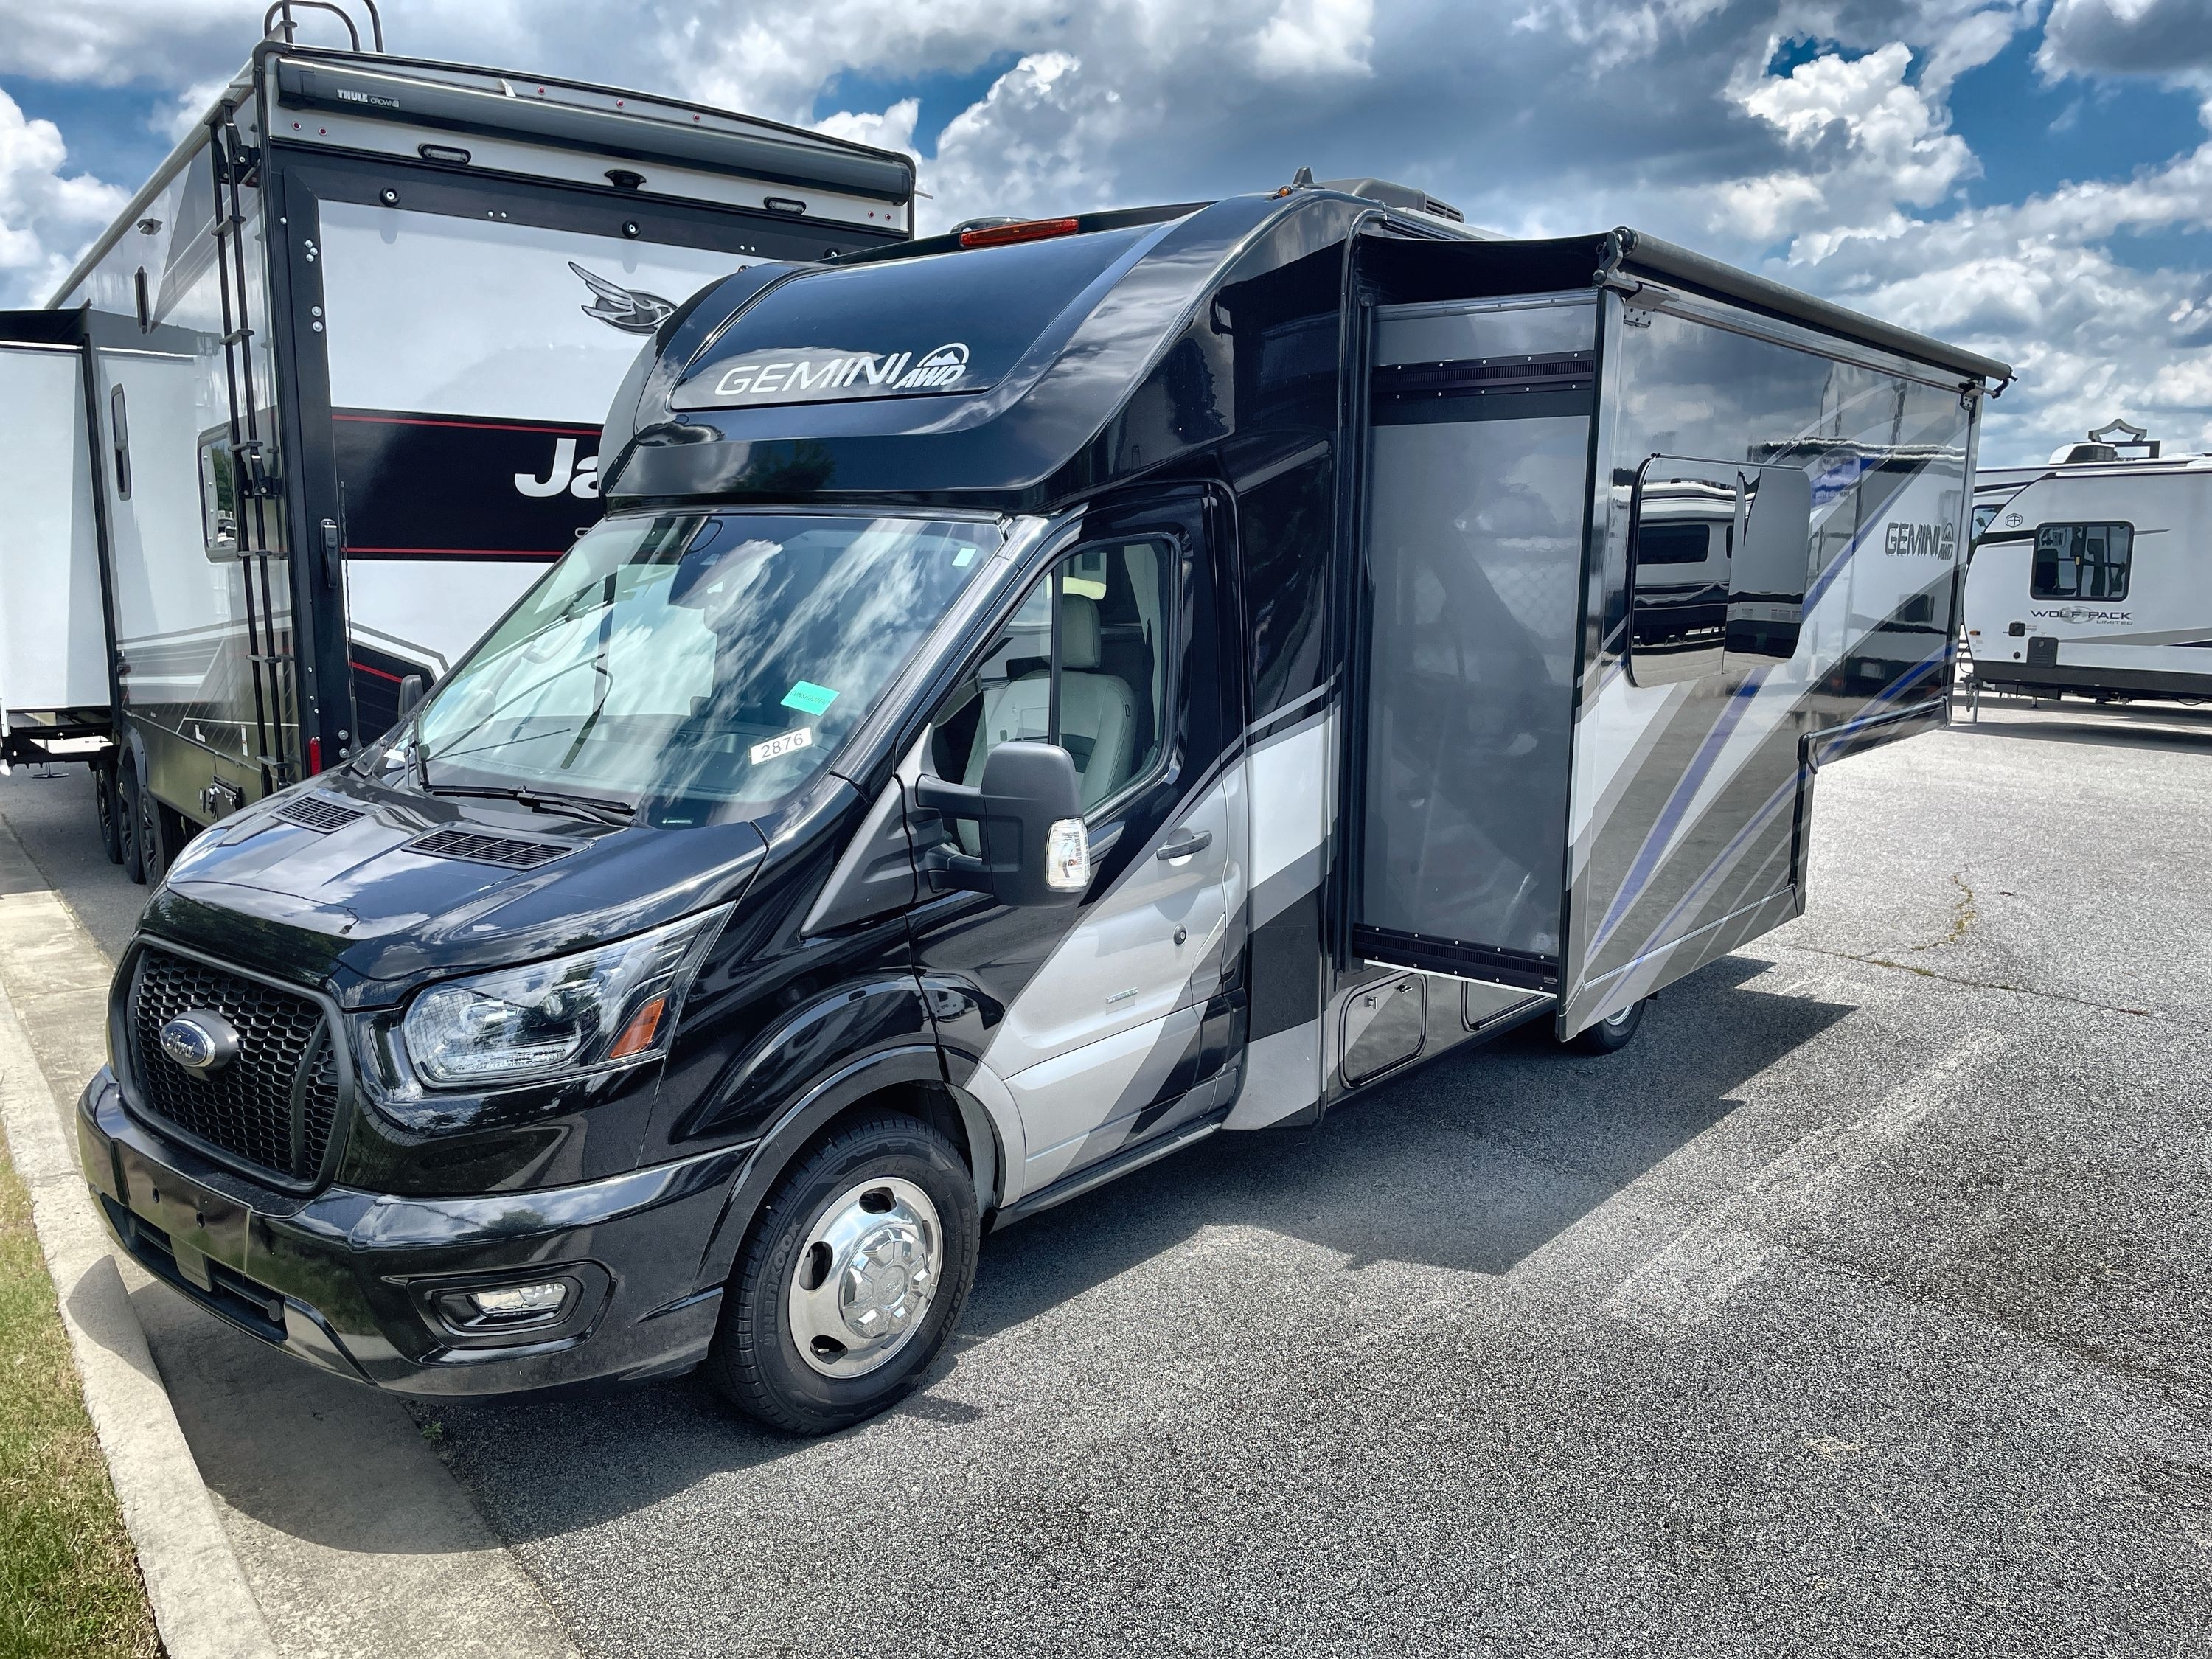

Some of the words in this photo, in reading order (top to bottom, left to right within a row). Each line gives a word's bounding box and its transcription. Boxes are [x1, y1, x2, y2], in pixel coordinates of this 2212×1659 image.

[337, 88, 369, 103] THULE
[714, 352, 912, 396] GEMINI
[891, 364, 967, 390] AWD
[1885, 522, 1941, 557] GEMINI
[1937, 543, 1954, 560] AWD
[2031, 609, 2083, 619] WOLF
[2088, 611, 2133, 620] PACK
[790, 690, 830, 706] CONSIGNMENT
[760, 733, 804, 758] 2876
[167, 1027, 195, 1059] Ford
